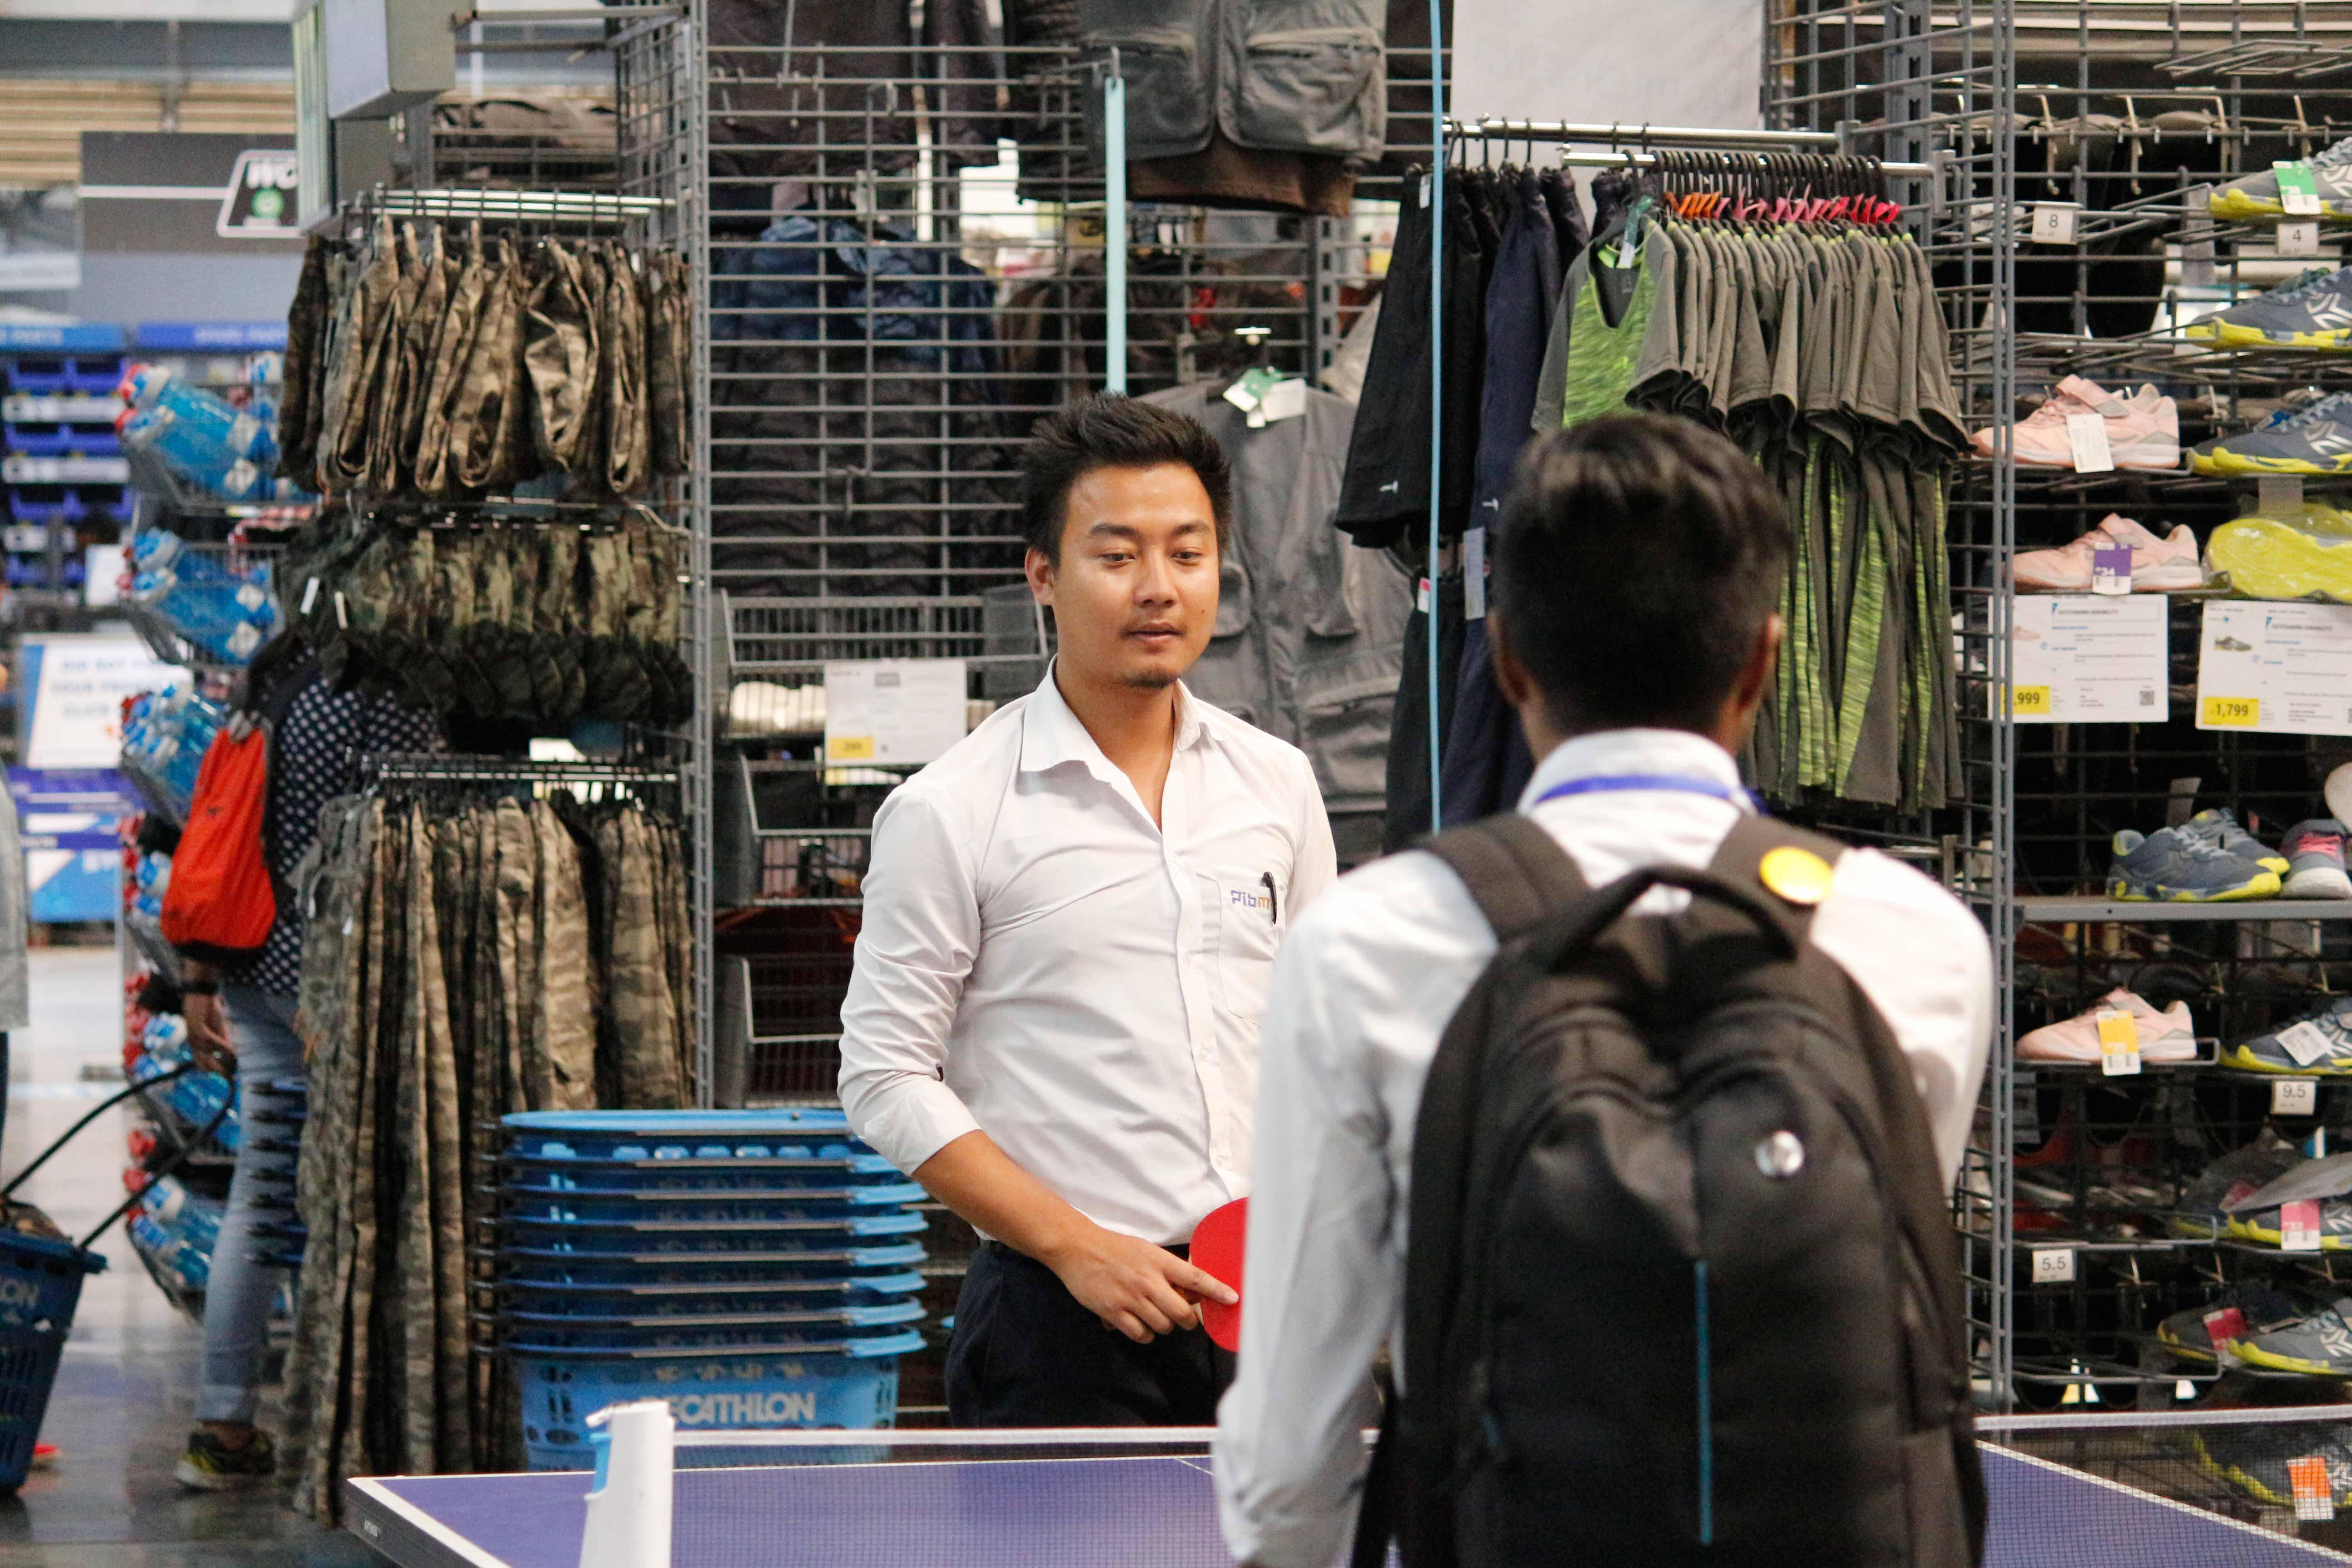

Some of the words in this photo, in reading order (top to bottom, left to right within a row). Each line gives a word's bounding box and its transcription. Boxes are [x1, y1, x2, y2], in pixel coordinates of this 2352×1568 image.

[2049, 214, 2058, 228] 8
[2293, 229, 2301, 242] 4
[2014, 692, 2040, 706] ,999
[2216, 703, 2249, 718] 1,799
[2283, 1084, 2305, 1098] 9.5
[2042, 1256, 2066, 1271] 5.5
[641, 1392, 816, 1424] ECATHLON
